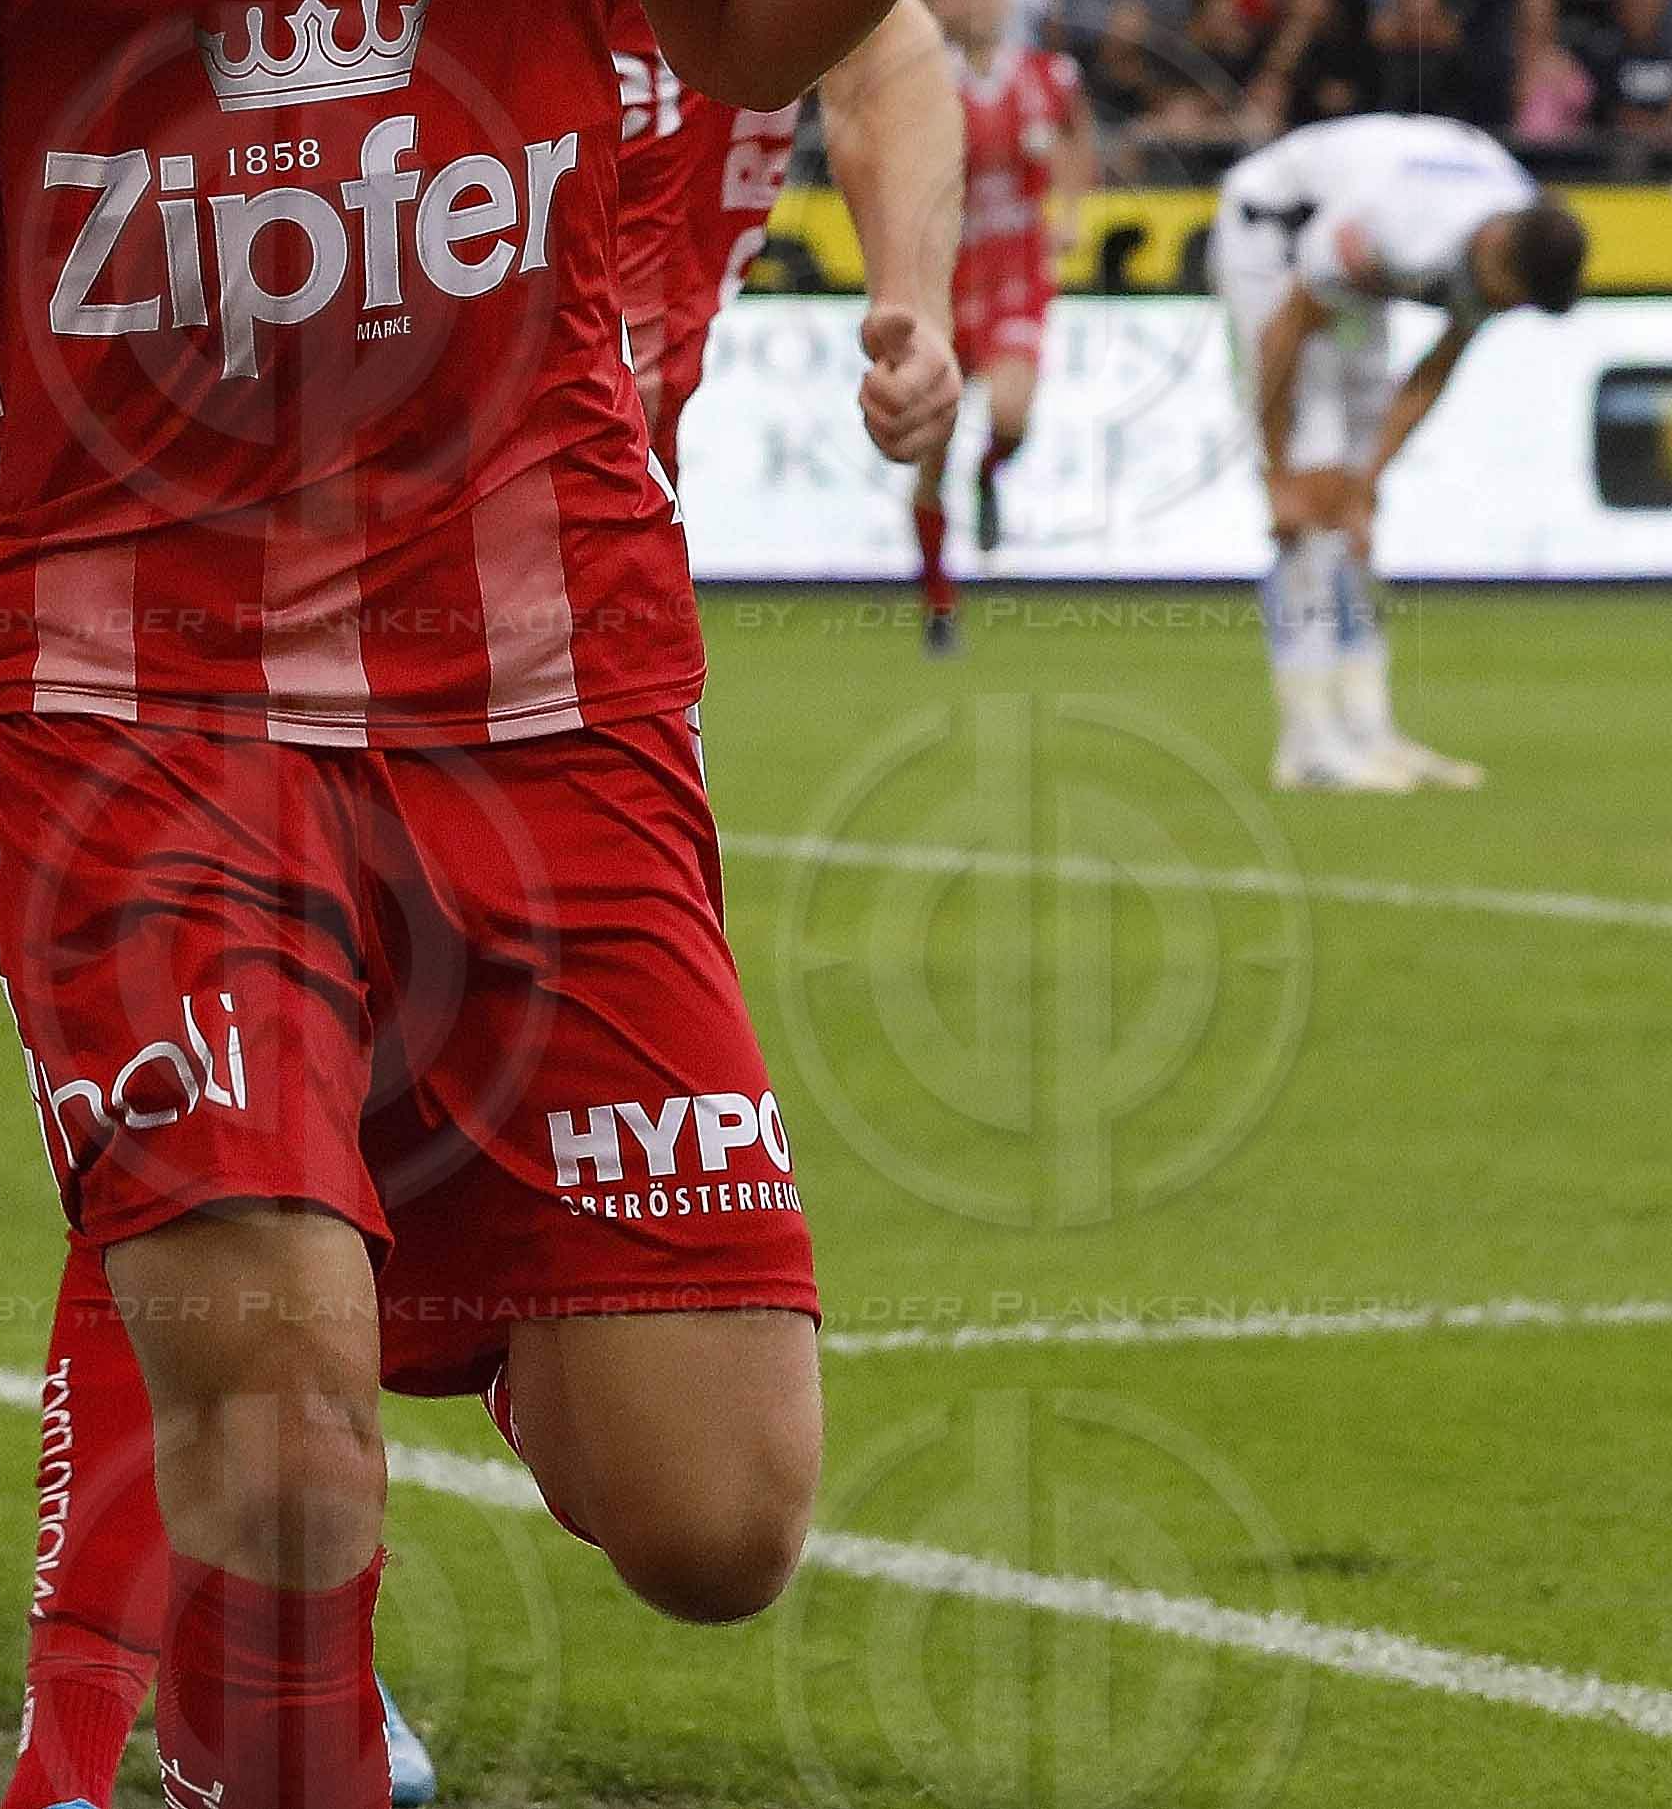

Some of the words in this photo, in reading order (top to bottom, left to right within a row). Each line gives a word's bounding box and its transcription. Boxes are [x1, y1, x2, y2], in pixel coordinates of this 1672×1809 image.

[226, 138, 321, 177] 1858
[42, 115, 578, 380] Zipfer
[356, 315, 413, 342] MARKE
[546, 1089, 792, 1187] HYPO
